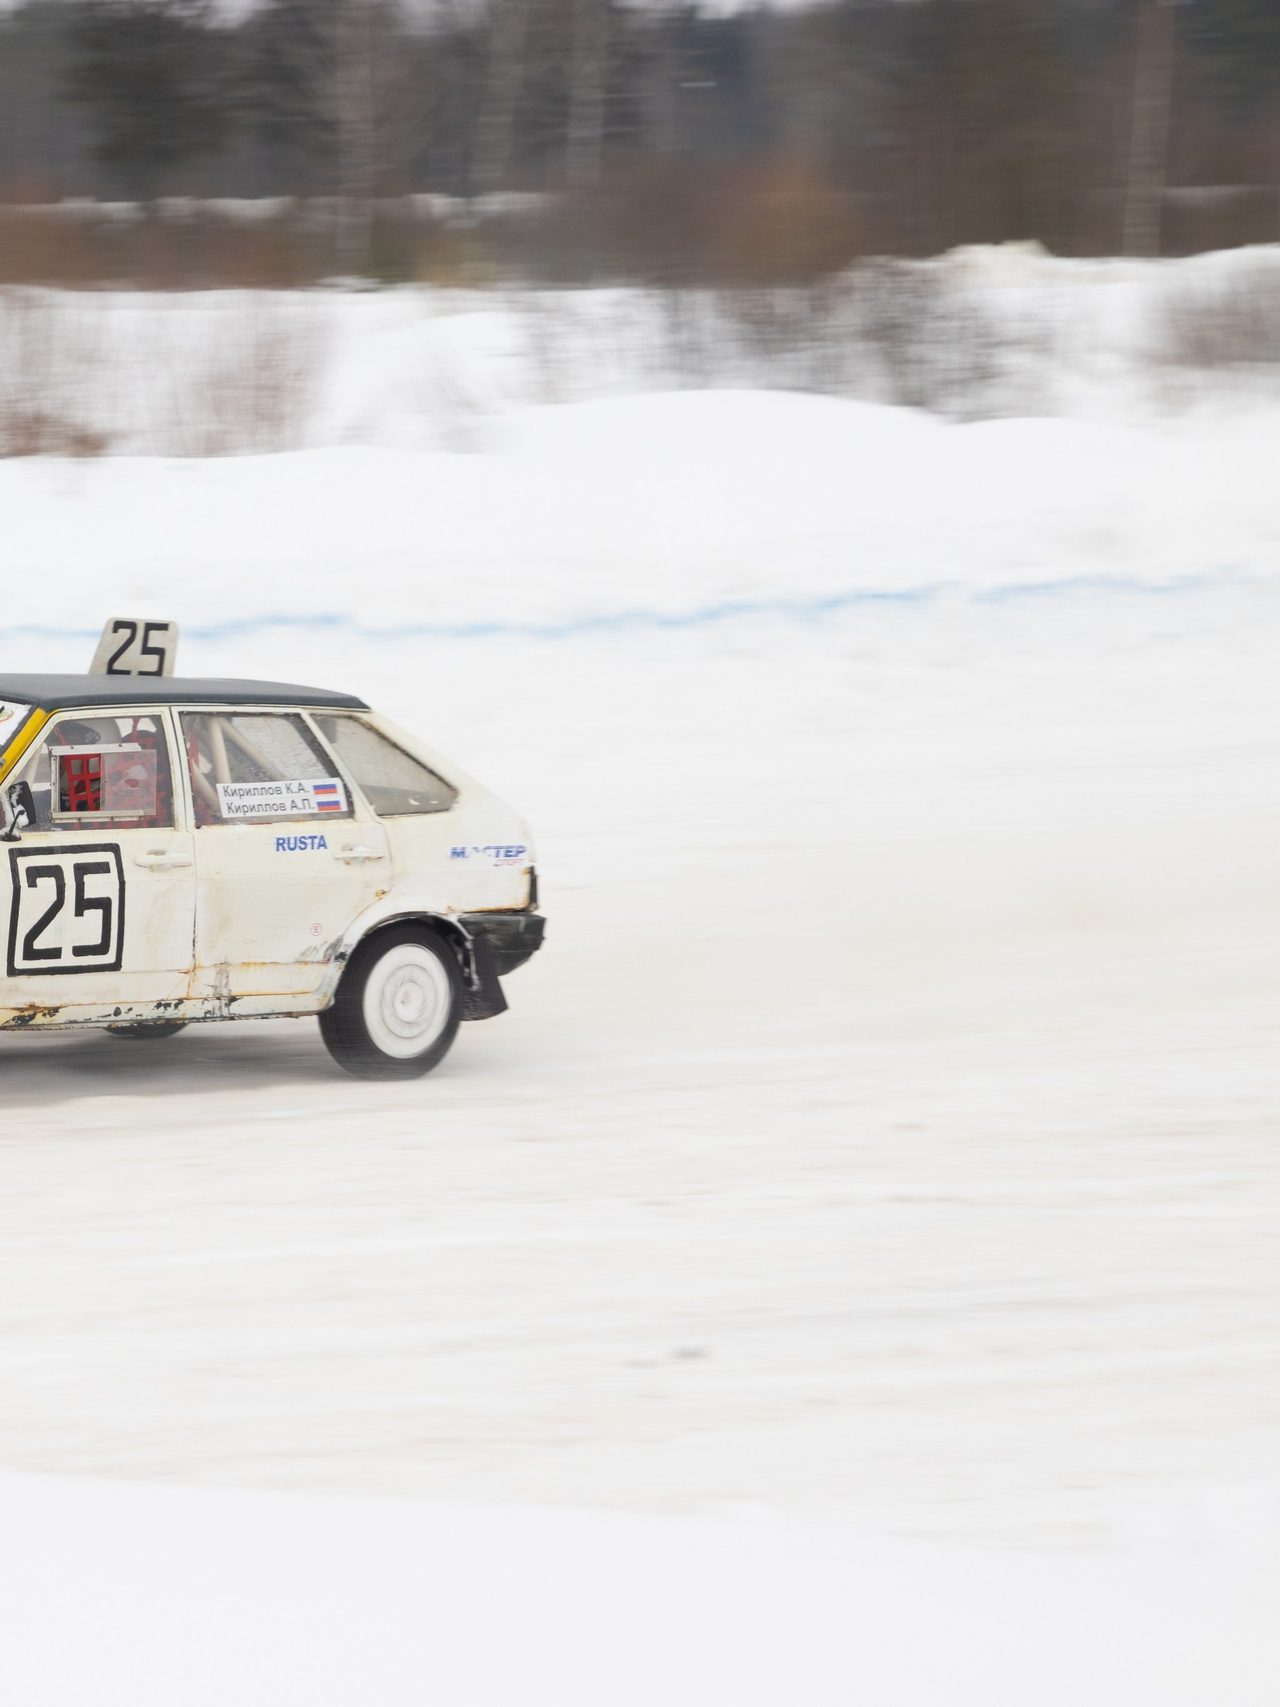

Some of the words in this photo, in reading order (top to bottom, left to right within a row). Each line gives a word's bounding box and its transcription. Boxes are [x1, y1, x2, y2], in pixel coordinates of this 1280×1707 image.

[106, 620, 169, 677] 25
[222, 785, 282, 799] Кириллов
[285, 782, 310, 795] К.А.
[226, 801, 287, 816] Кириллов
[290, 798, 316, 811] А.П.
[275, 835, 328, 852] RUSTA
[450, 845, 526, 859] МТЕР
[22, 861, 111, 961] 25
